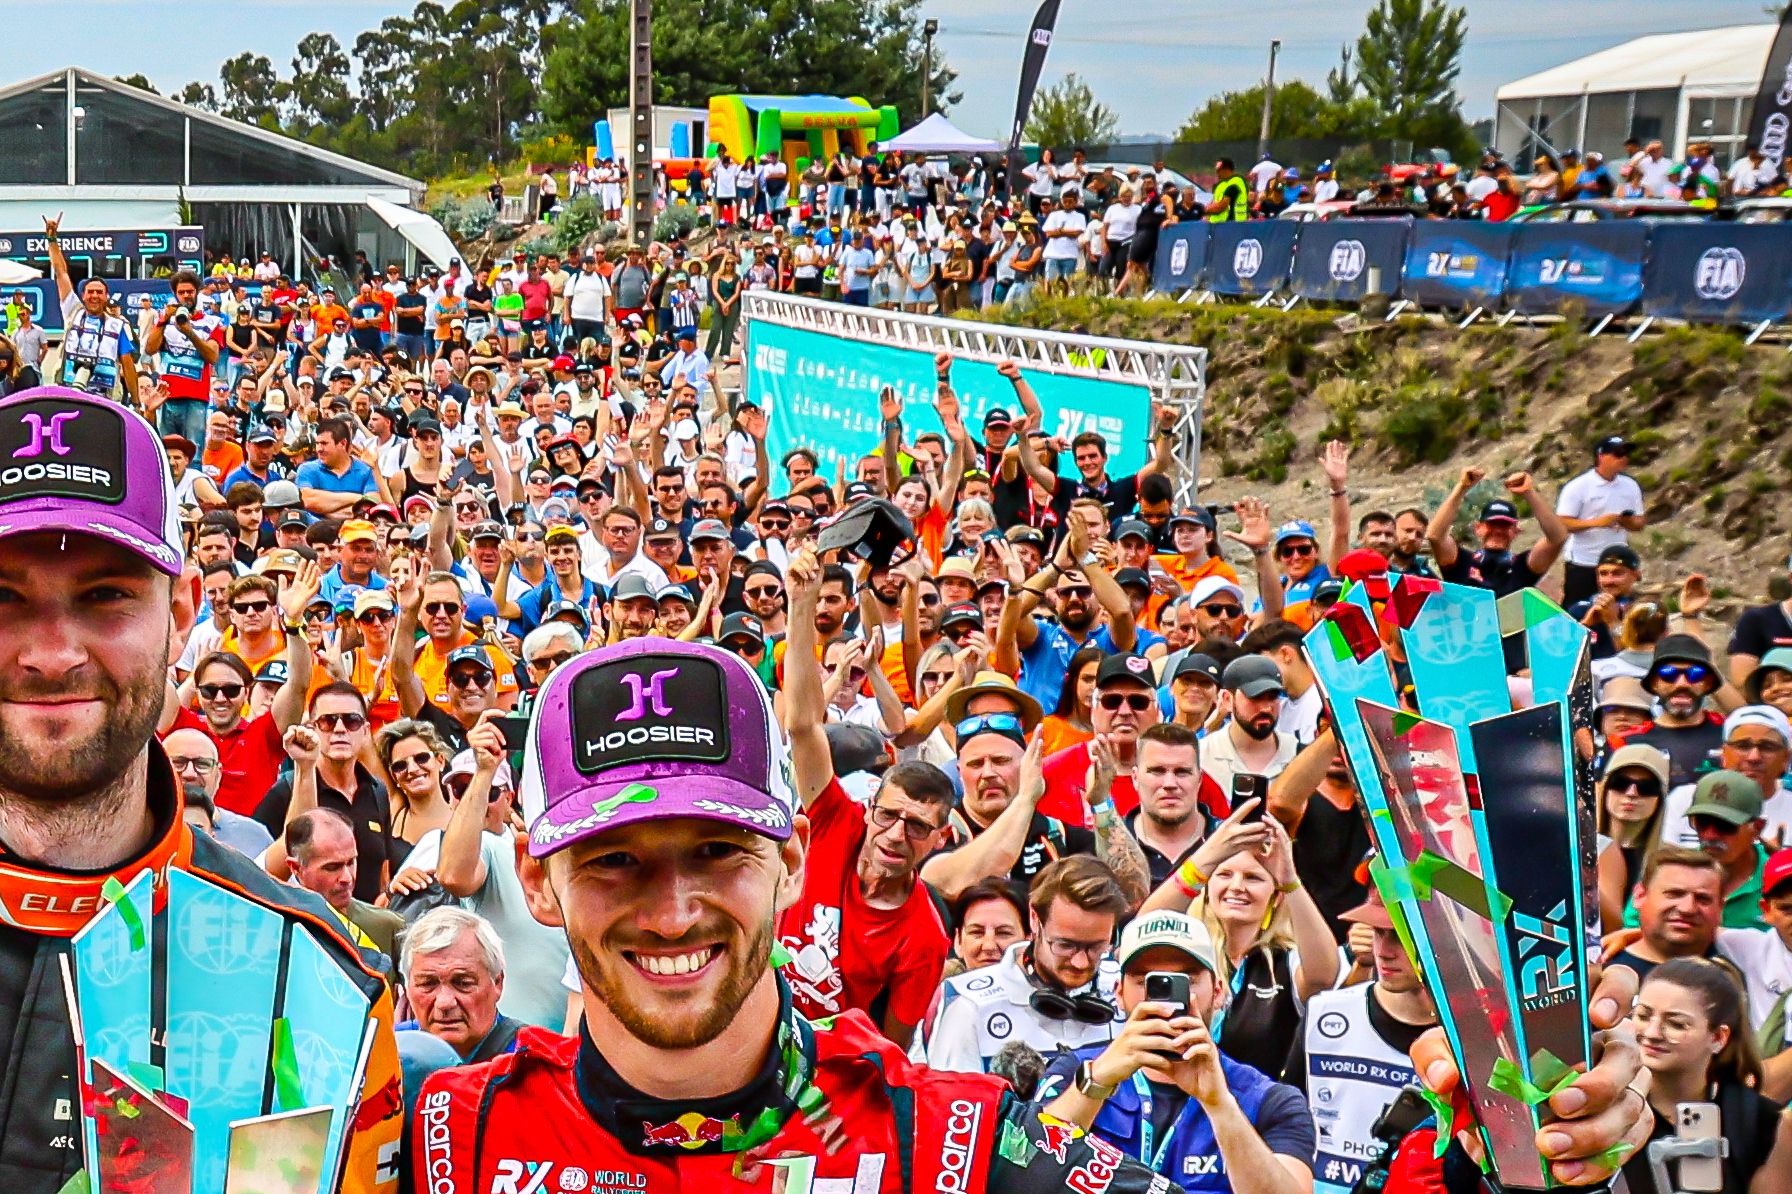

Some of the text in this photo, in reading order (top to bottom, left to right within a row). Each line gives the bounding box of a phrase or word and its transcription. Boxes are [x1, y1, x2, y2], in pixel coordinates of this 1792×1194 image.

[1235, 245, 1262, 272] FIA
[1330, 246, 1365, 275] FIA
[1697, 256, 1742, 292] FIA
[586, 725, 715, 757] HOOSIER
[1320, 1060, 1410, 1084] WORLD RX OF
[594, 1170, 646, 1188] WORLD
